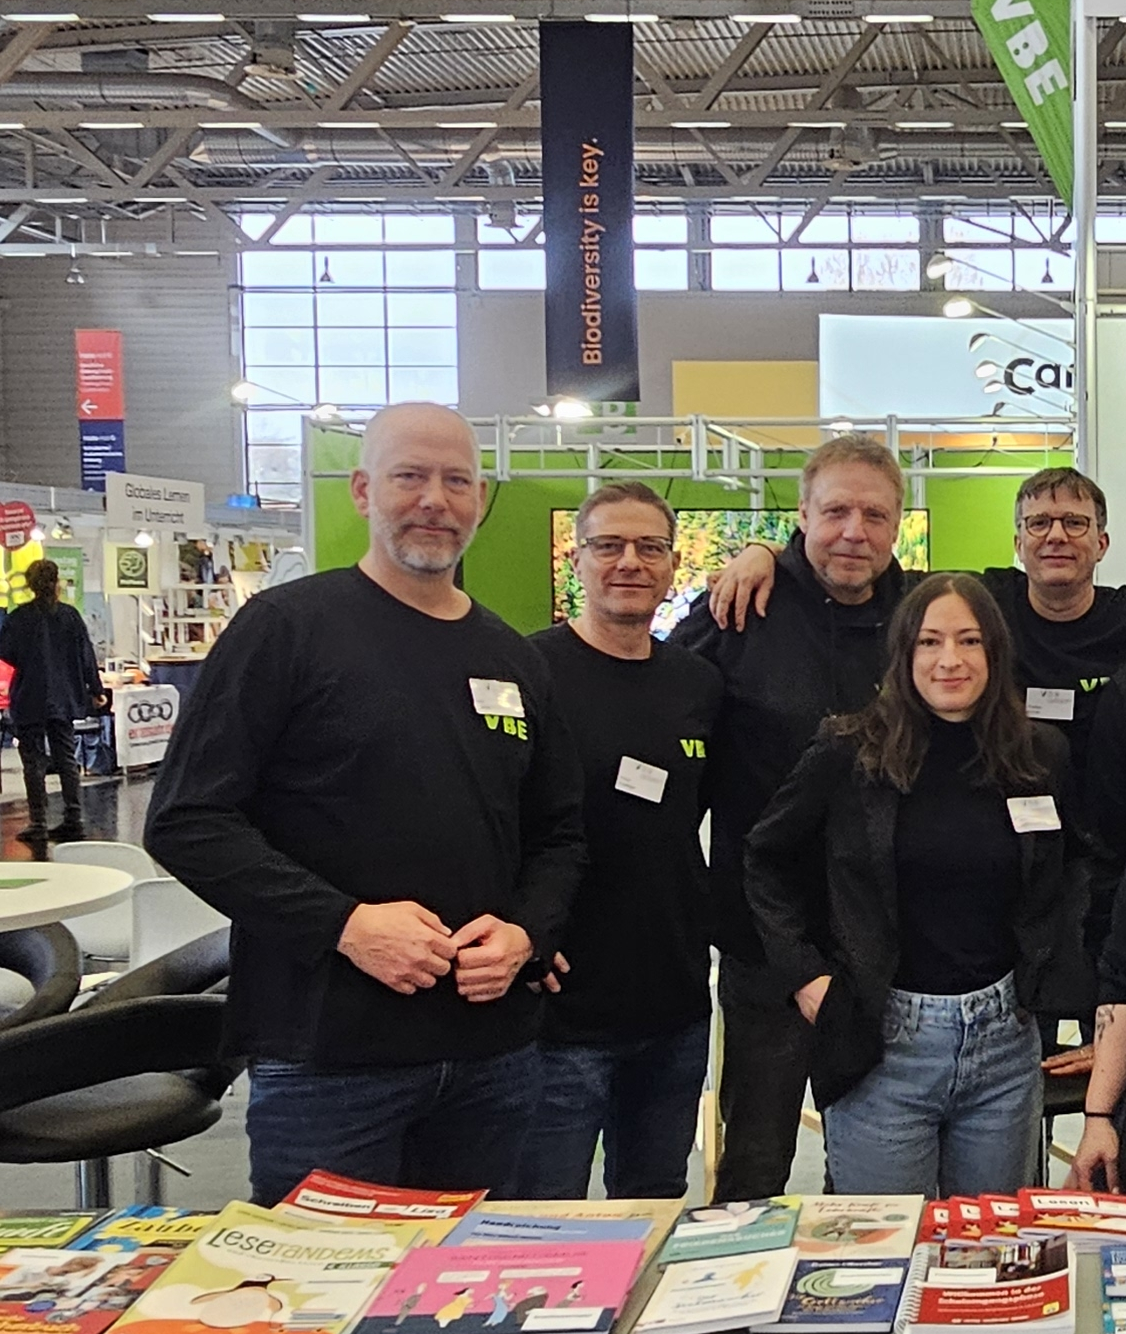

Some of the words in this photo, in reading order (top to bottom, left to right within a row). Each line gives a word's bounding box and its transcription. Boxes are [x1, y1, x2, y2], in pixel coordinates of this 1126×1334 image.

[579, 137, 605, 187] key.
[579, 193, 600, 214] is
[580, 220, 606, 365] Biodiversity
